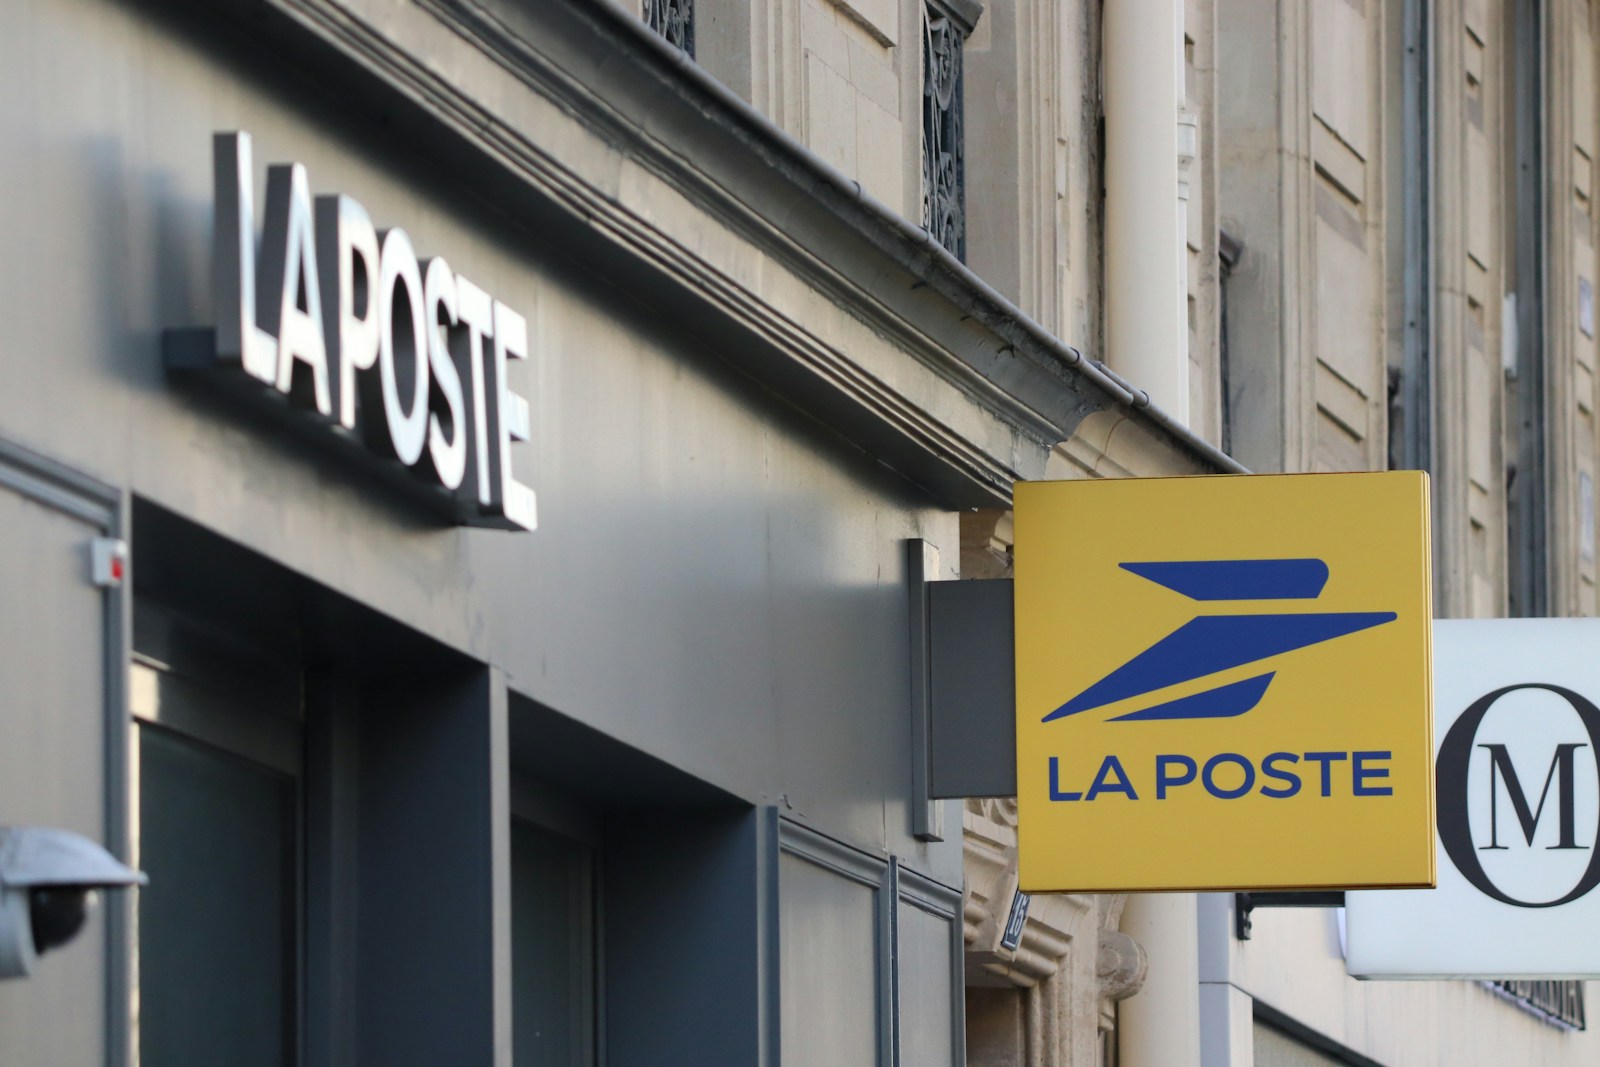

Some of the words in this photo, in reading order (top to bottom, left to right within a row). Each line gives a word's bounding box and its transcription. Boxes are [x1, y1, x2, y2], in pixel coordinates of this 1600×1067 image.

[236, 130, 332, 417] LA
[338, 194, 538, 532] POSTE
[1048, 755, 1140, 801] LA
[1156, 751, 1393, 800] POSTE
